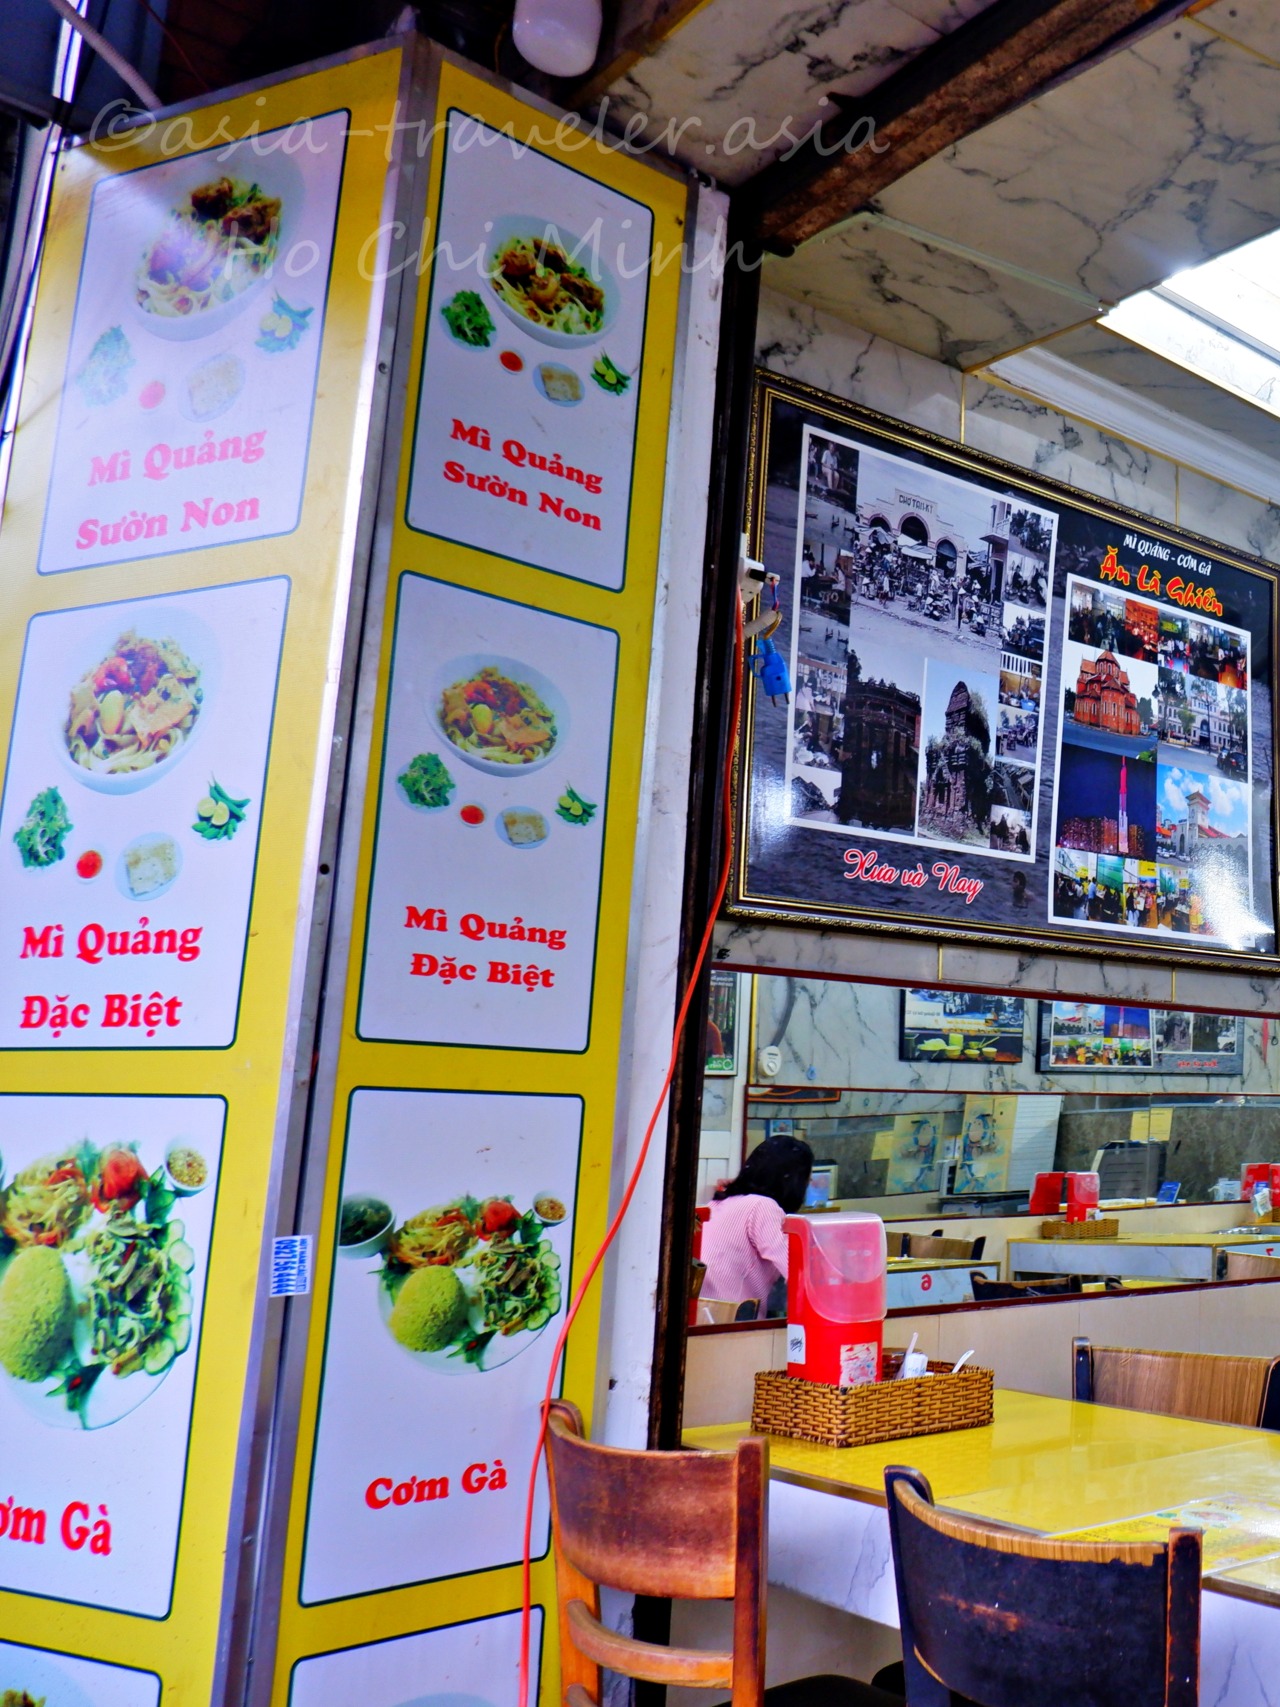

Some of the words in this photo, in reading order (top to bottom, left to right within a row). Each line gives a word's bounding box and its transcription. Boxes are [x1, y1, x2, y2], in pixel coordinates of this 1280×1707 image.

[88, 450, 131, 487] Mì
[143, 428, 268, 482] Quảng
[451, 419, 491, 452] Mì
[502, 437, 604, 495] Quảng
[442, 460, 529, 509] Sườn
[538, 491, 603, 532] Non
[75, 510, 168, 551] Sườn
[180, 496, 260, 532] Non
[1100, 545, 1131, 586] Ăn
[1137, 565, 1161, 595] Là
[1123, 534, 1137, 550] MÌ
[1137, 540, 1171, 561] QUẢNG
[1177, 554, 1197, 572] CƠM
[1198, 561, 1212, 576] GÀ
[844, 849, 900, 884] Xưa
[901, 863, 929, 888] và
[932, 862, 984, 904] Nay
[20, 924, 64, 960] Mì
[76, 916, 203, 964] Quảng
[405, 905, 448, 933] Mì
[459, 912, 567, 951] Quảng
[410, 953, 476, 985] Đặc
[487, 960, 555, 993] Biệt
[19, 995, 90, 1038] Đặc
[101, 991, 182, 1038] Biệt
[364, 1475, 450, 1510] Cơm
[461, 1459, 508, 1492] Gà
[60, 1501, 112, 1556] Gà
